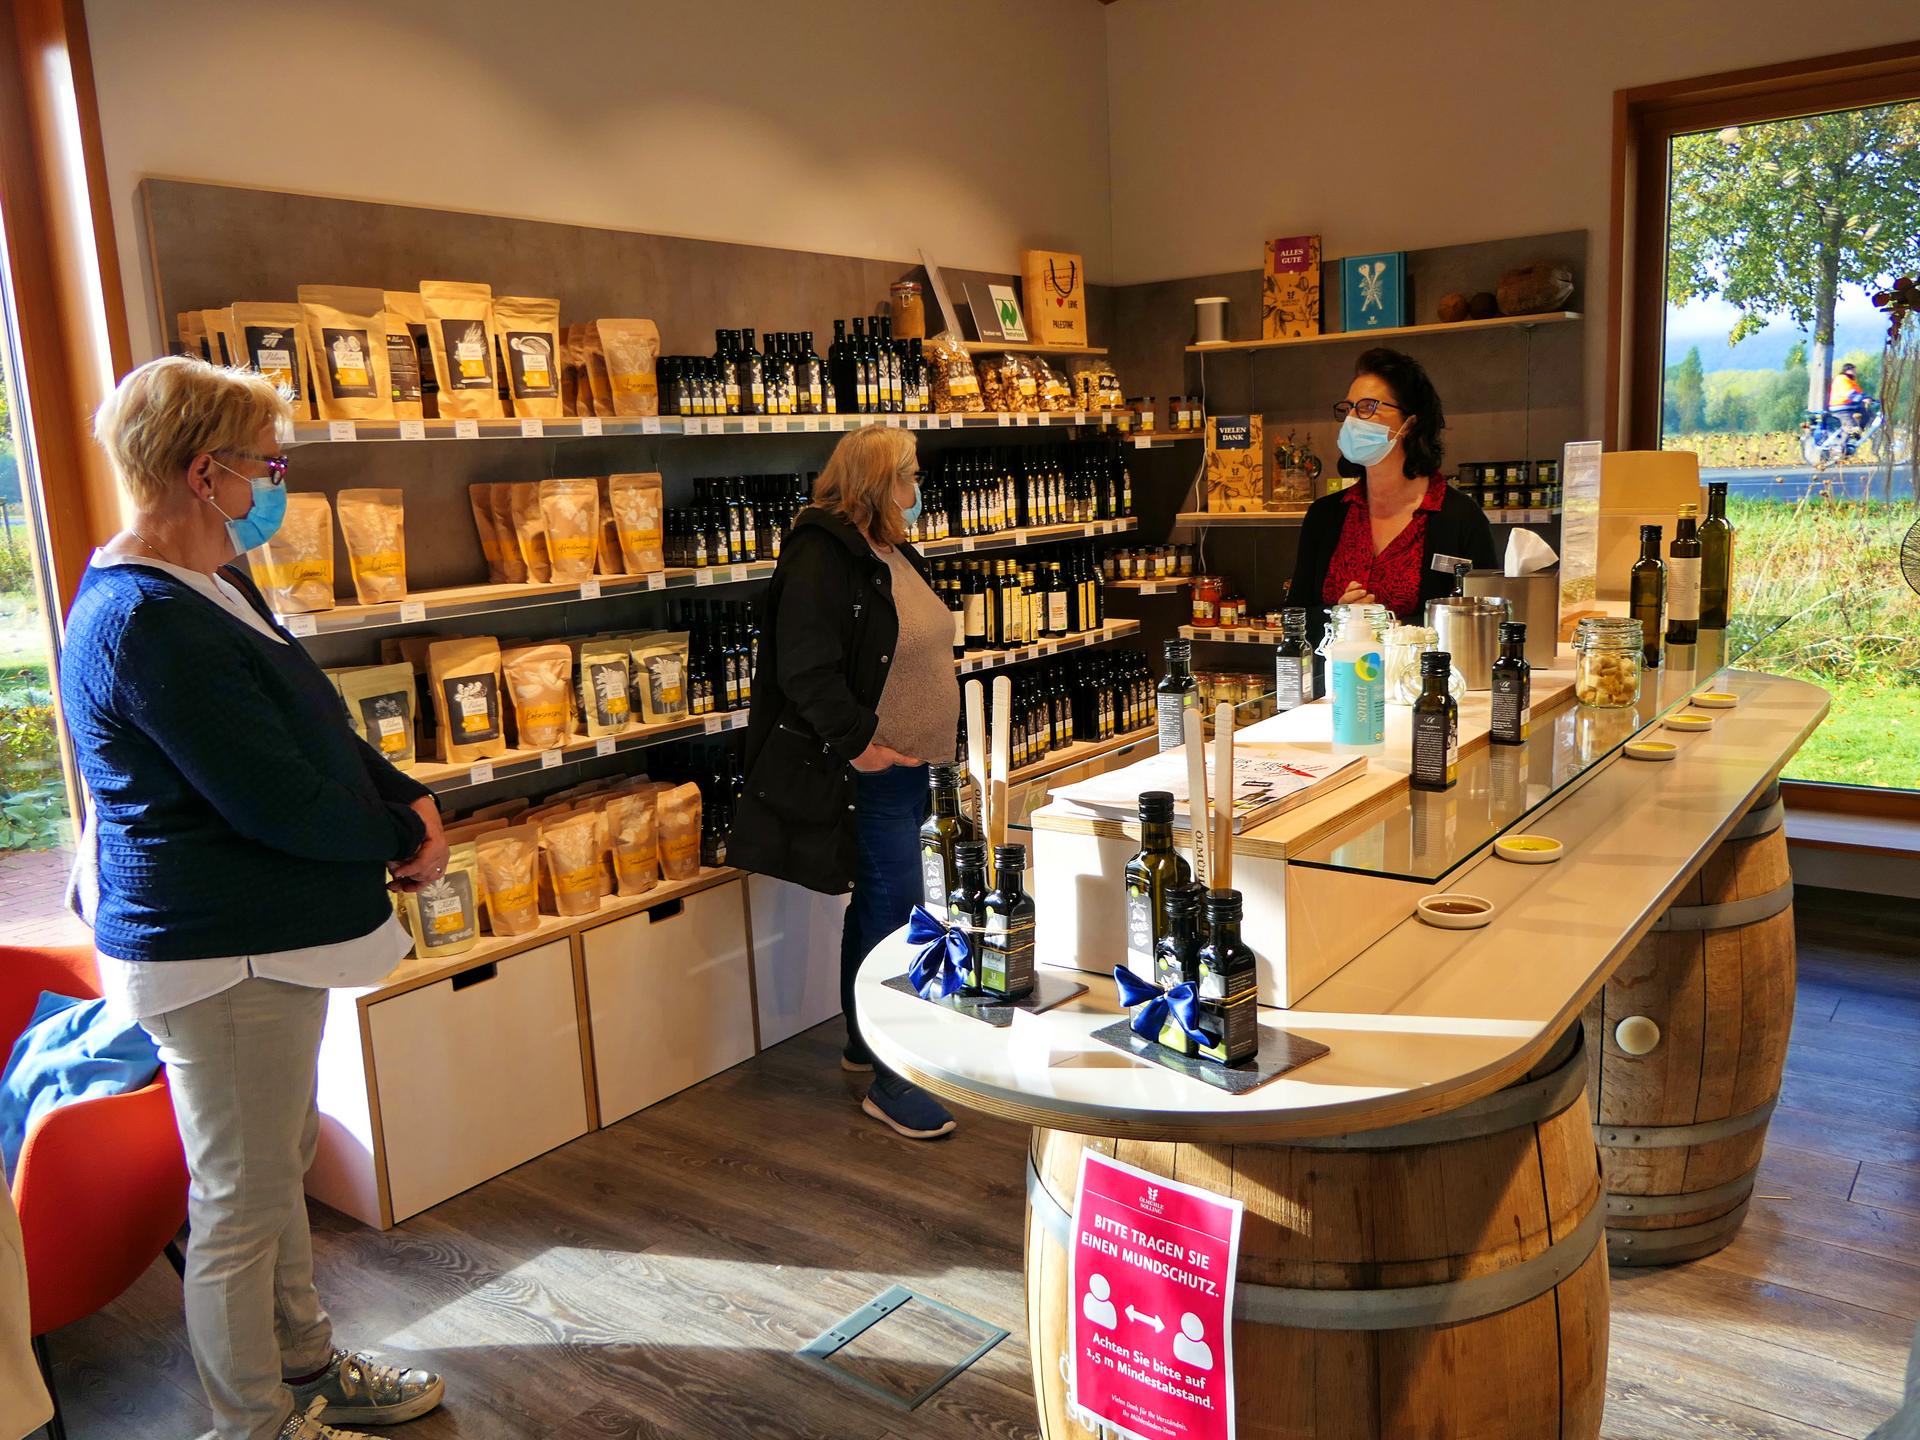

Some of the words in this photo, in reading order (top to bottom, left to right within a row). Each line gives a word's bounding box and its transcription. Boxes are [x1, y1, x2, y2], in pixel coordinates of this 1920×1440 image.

[1280, 248, 1304, 257] ALLES
[1281, 256, 1303, 265] GUTE
[1219, 426, 1247, 434] VIELEN
[1356, 684, 1368, 722] sonett
[1094, 1213, 1129, 1240] BITTE
[1131, 1228, 1184, 1260] TRAGEN
[1188, 1249, 1210, 1270] SIE
[1081, 1230, 1118, 1257] EINEN
[1122, 1248, 1220, 1298] MUNDSCHUTZ.
[1086, 1347, 1101, 1365] 1,5
[1103, 1357, 1114, 1369] m
[1117, 1360, 1215, 1410] Mindestabstand.
[1092, 1331, 1130, 1359] Achten
[1133, 1350, 1151, 1368] Sie
[1153, 1358, 1182, 1380] bitte
[1185, 1374, 1207, 1390] auf
[1111, 1393, 1126, 1406] Vielen
[1126, 1400, 1139, 1412] Dank
[1139, 1406, 1147, 1416] für
[1147, 1410, 1156, 1419] Ihr
[1156, 1413, 1189, 1432] Verständnis.
[1122, 1409, 1130, 1418] Ihr
[1129, 1413, 1177, 1437] Mühlenladen-Team
